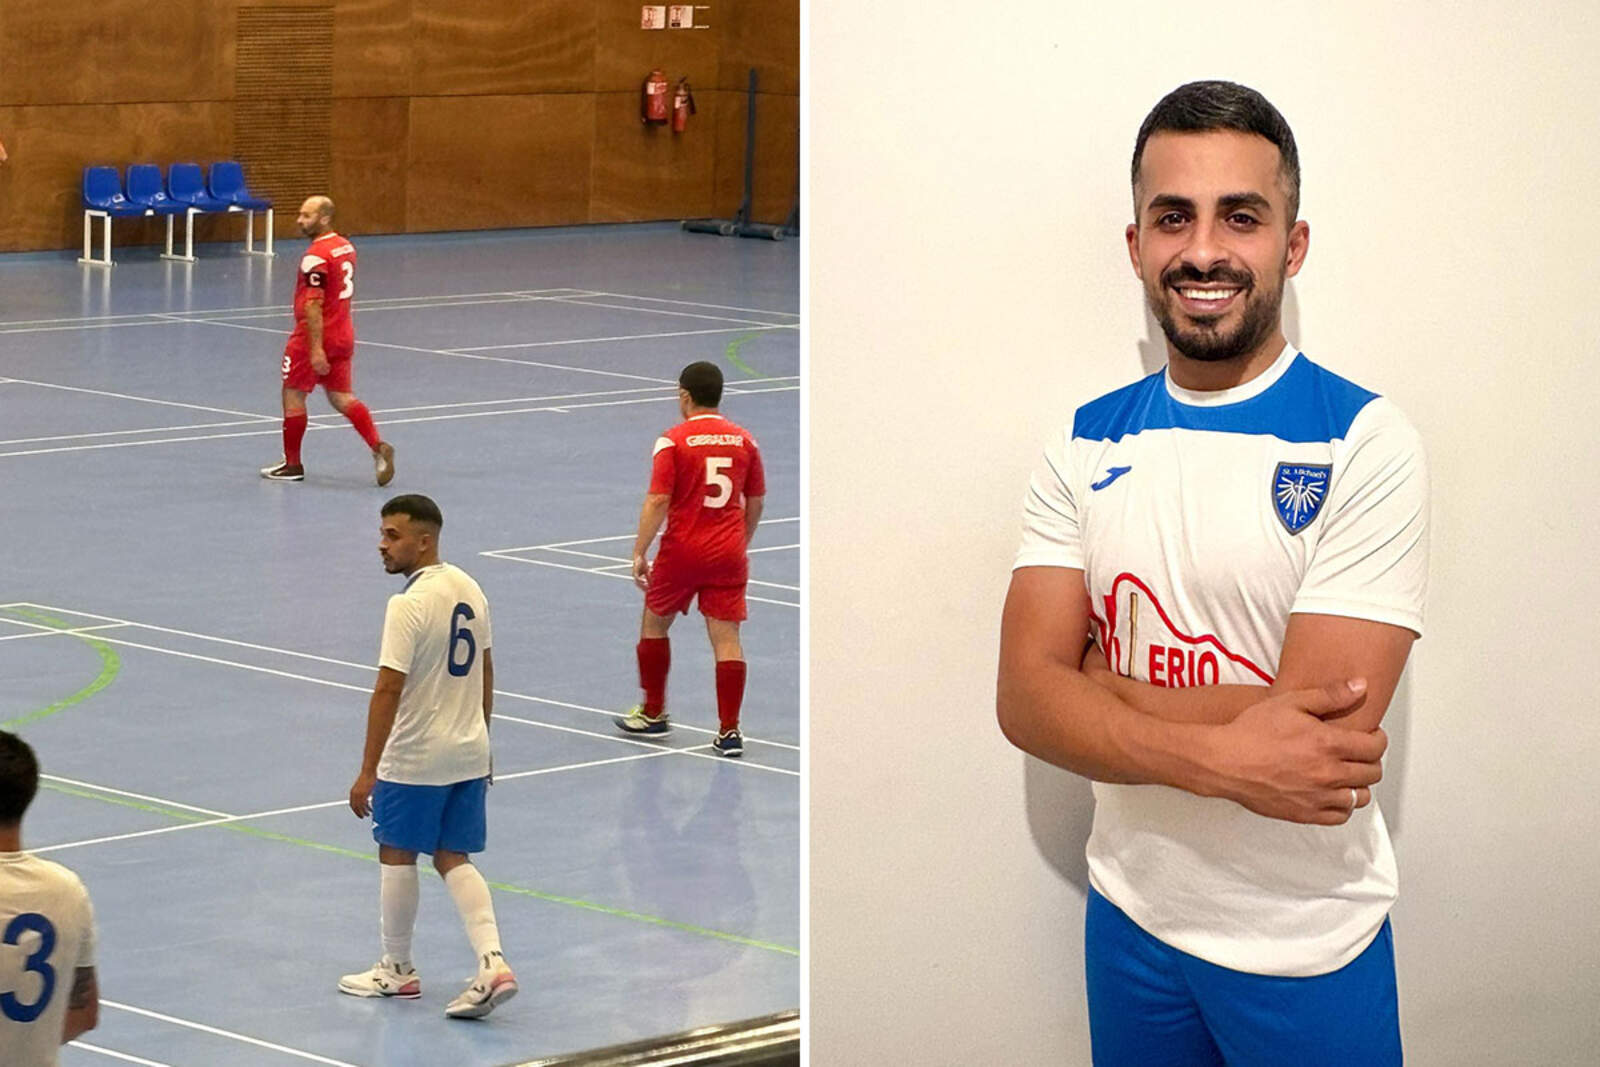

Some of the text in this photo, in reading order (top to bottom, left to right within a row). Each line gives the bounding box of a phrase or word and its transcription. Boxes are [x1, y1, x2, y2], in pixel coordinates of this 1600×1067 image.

[310, 273, 320, 286] C
[339, 261, 353, 299] 3
[281, 355, 291, 373] 3
[703, 457, 733, 509] 5
[448, 602, 476, 677] 6
[0, 912, 57, 1023] 3
